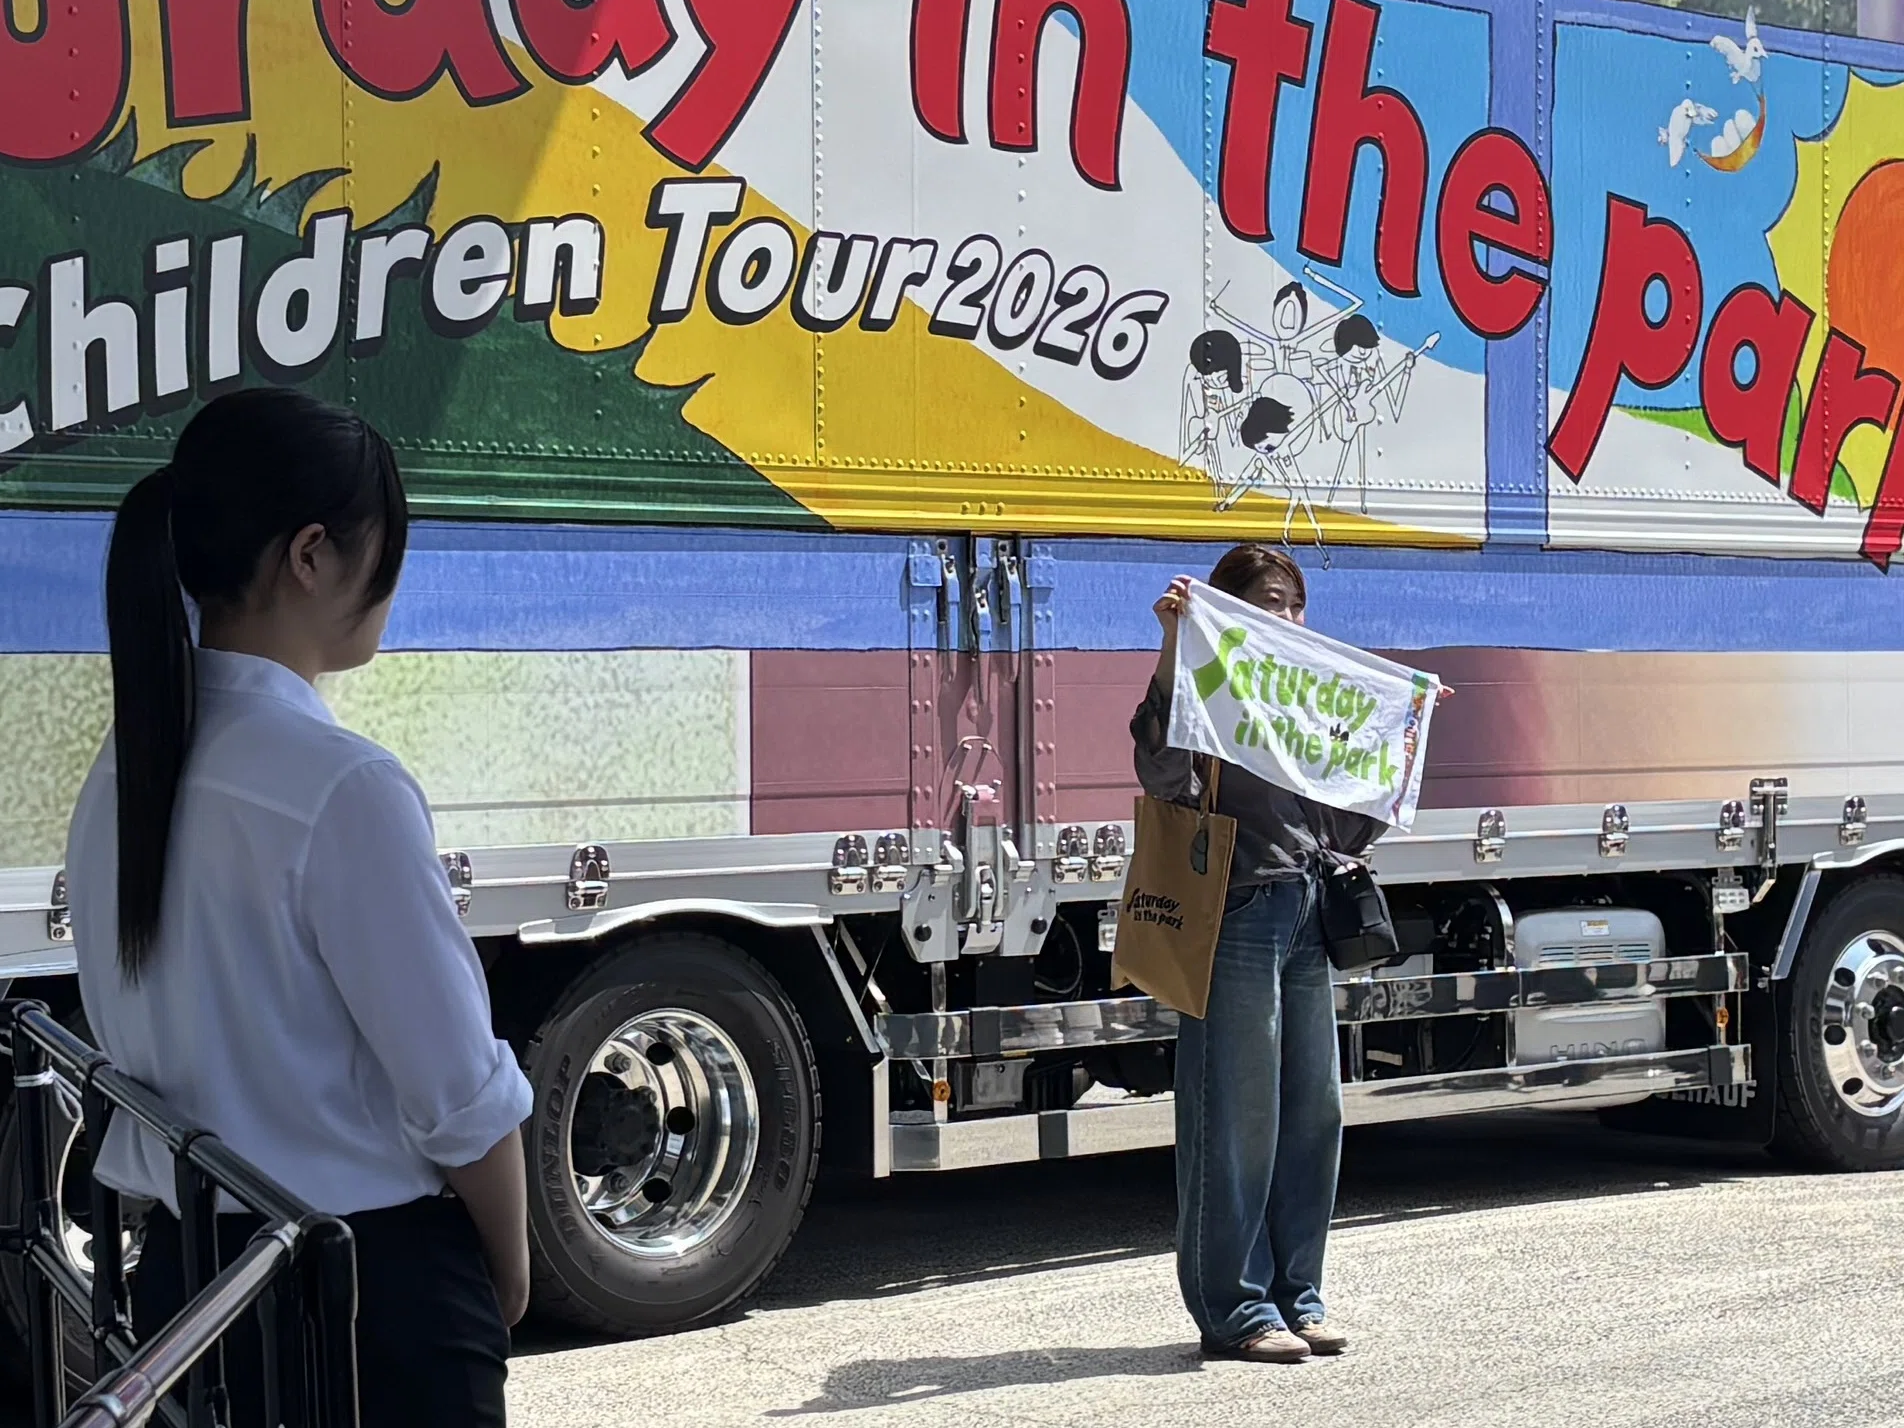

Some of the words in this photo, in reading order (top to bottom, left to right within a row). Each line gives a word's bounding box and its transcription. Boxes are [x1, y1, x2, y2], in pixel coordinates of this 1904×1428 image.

[646, 177, 938, 333] Tour
[928, 234, 1170, 380] 2026
[1192, 626, 1377, 734] Saturday
[1321, 739, 1399, 794] park
[1126, 887, 1180, 912] Saturday
